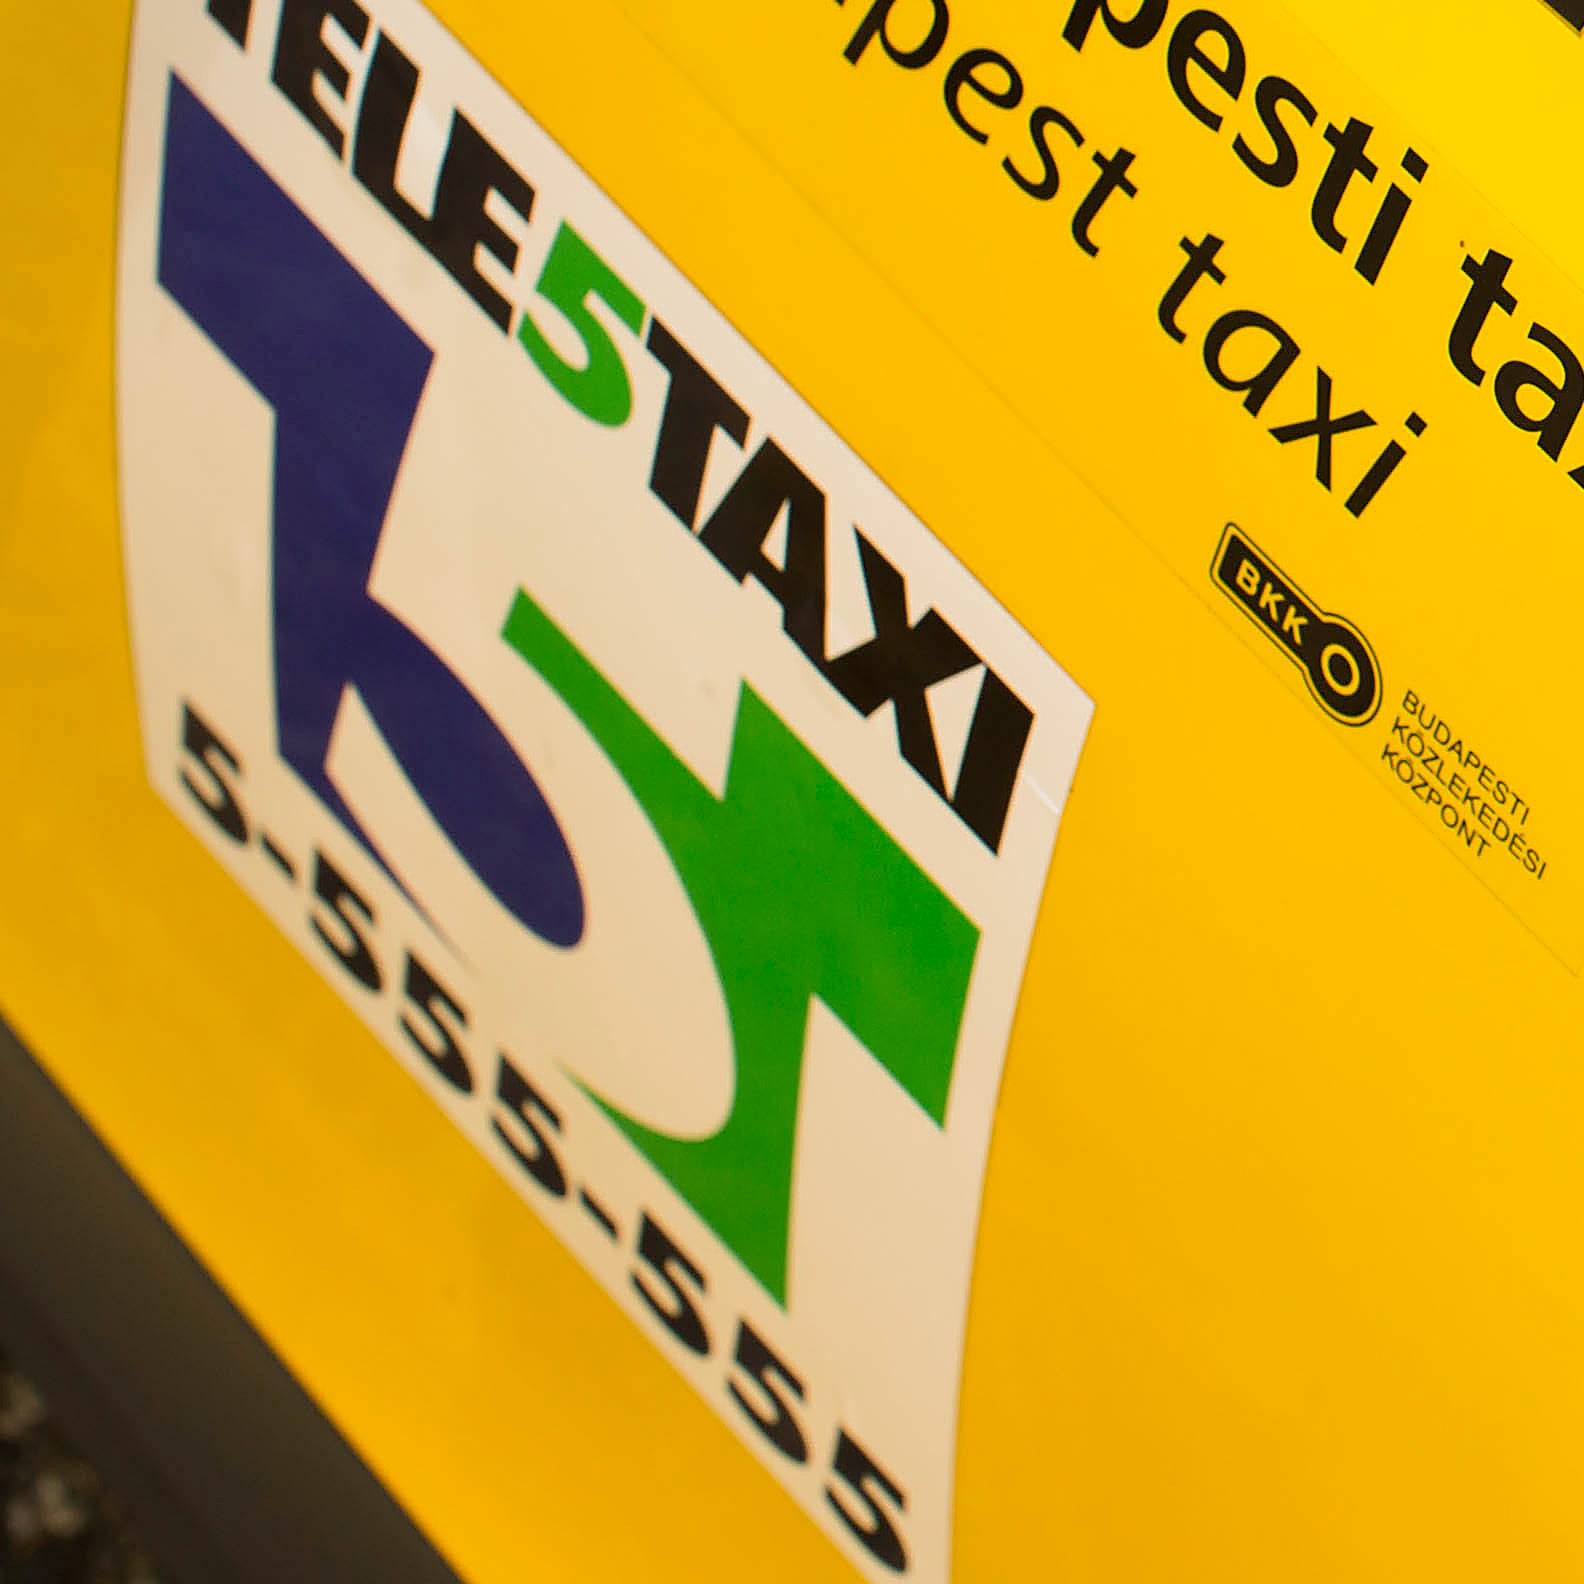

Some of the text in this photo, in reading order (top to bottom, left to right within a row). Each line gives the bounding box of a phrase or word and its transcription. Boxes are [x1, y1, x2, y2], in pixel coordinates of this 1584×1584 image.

[1156, 233, 1427, 517] taxi
[1380, 744, 1490, 857] KÖZPONT
[1392, 717, 1547, 880] KÖZLEKEDÉSI
[1402, 689, 1530, 825] BUDAPESTI
[175, 698, 911, 1576] 5-555-555
